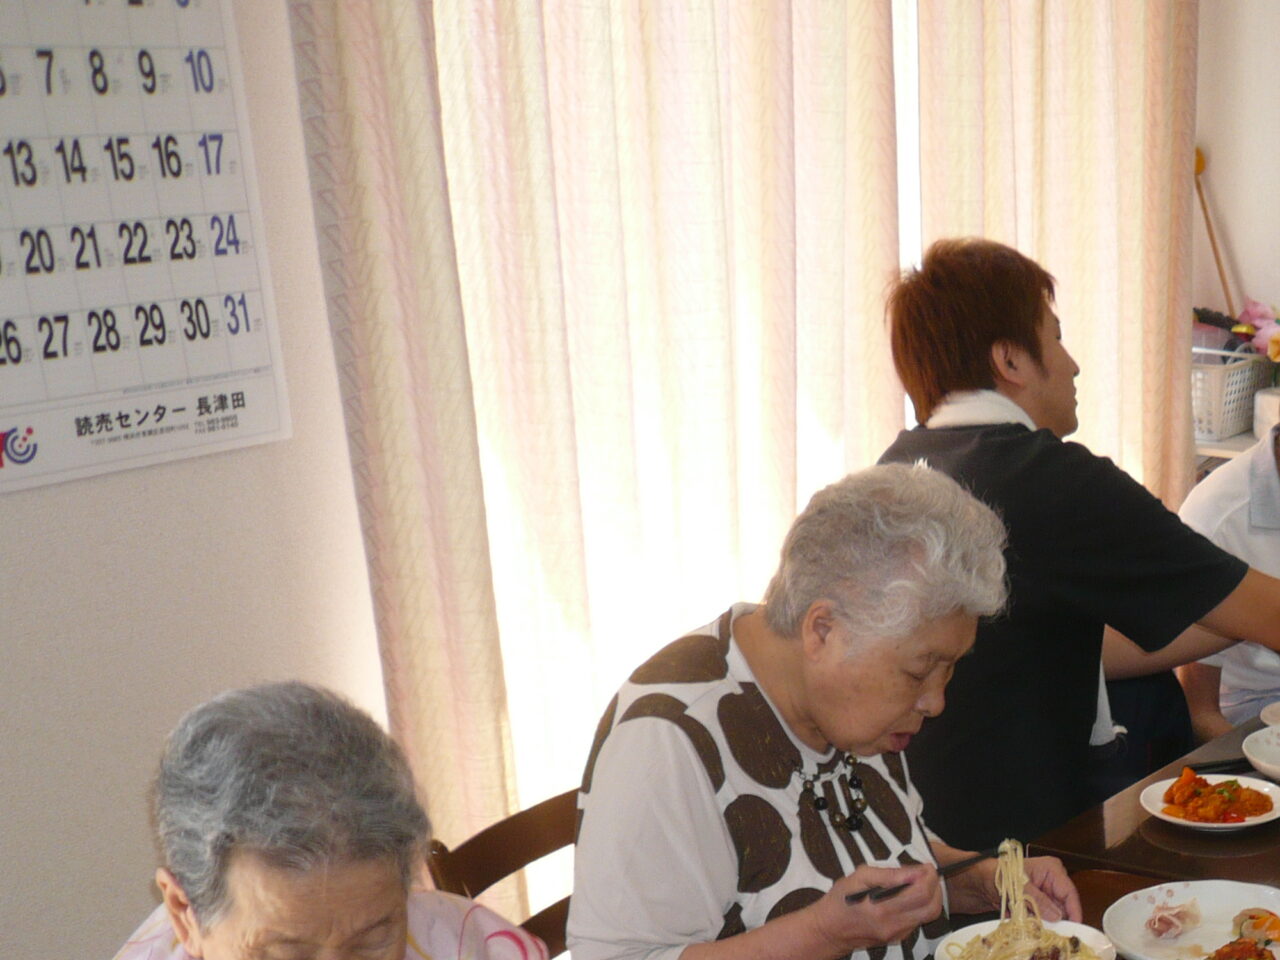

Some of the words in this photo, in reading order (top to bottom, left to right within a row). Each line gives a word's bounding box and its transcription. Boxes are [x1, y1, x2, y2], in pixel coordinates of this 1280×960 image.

[36, 49, 53, 94] 7
[89, 49, 108, 94] 8
[138, 49, 156, 93] 9
[185, 50, 214, 93] 10
[3, 139, 37, 187] 13
[55, 138, 87, 182] 14
[104, 137, 134, 181] 15
[152, 135, 182, 178] 16
[198, 133, 223, 175] 17
[20, 229, 54, 274] 20
[70, 224, 101, 269] 21
[118, 221, 152, 264] 22
[166, 217, 196, 260] 23
[211, 213, 240, 255] 24
[38, 314, 69, 359] 27
[88, 308, 120, 352] 28
[135, 303, 166, 346] 29
[181, 297, 210, 341] 30
[224, 293, 250, 335] 31
[74, 404, 187, 437] 読売センター
[196, 391, 246, 417] 長津田
